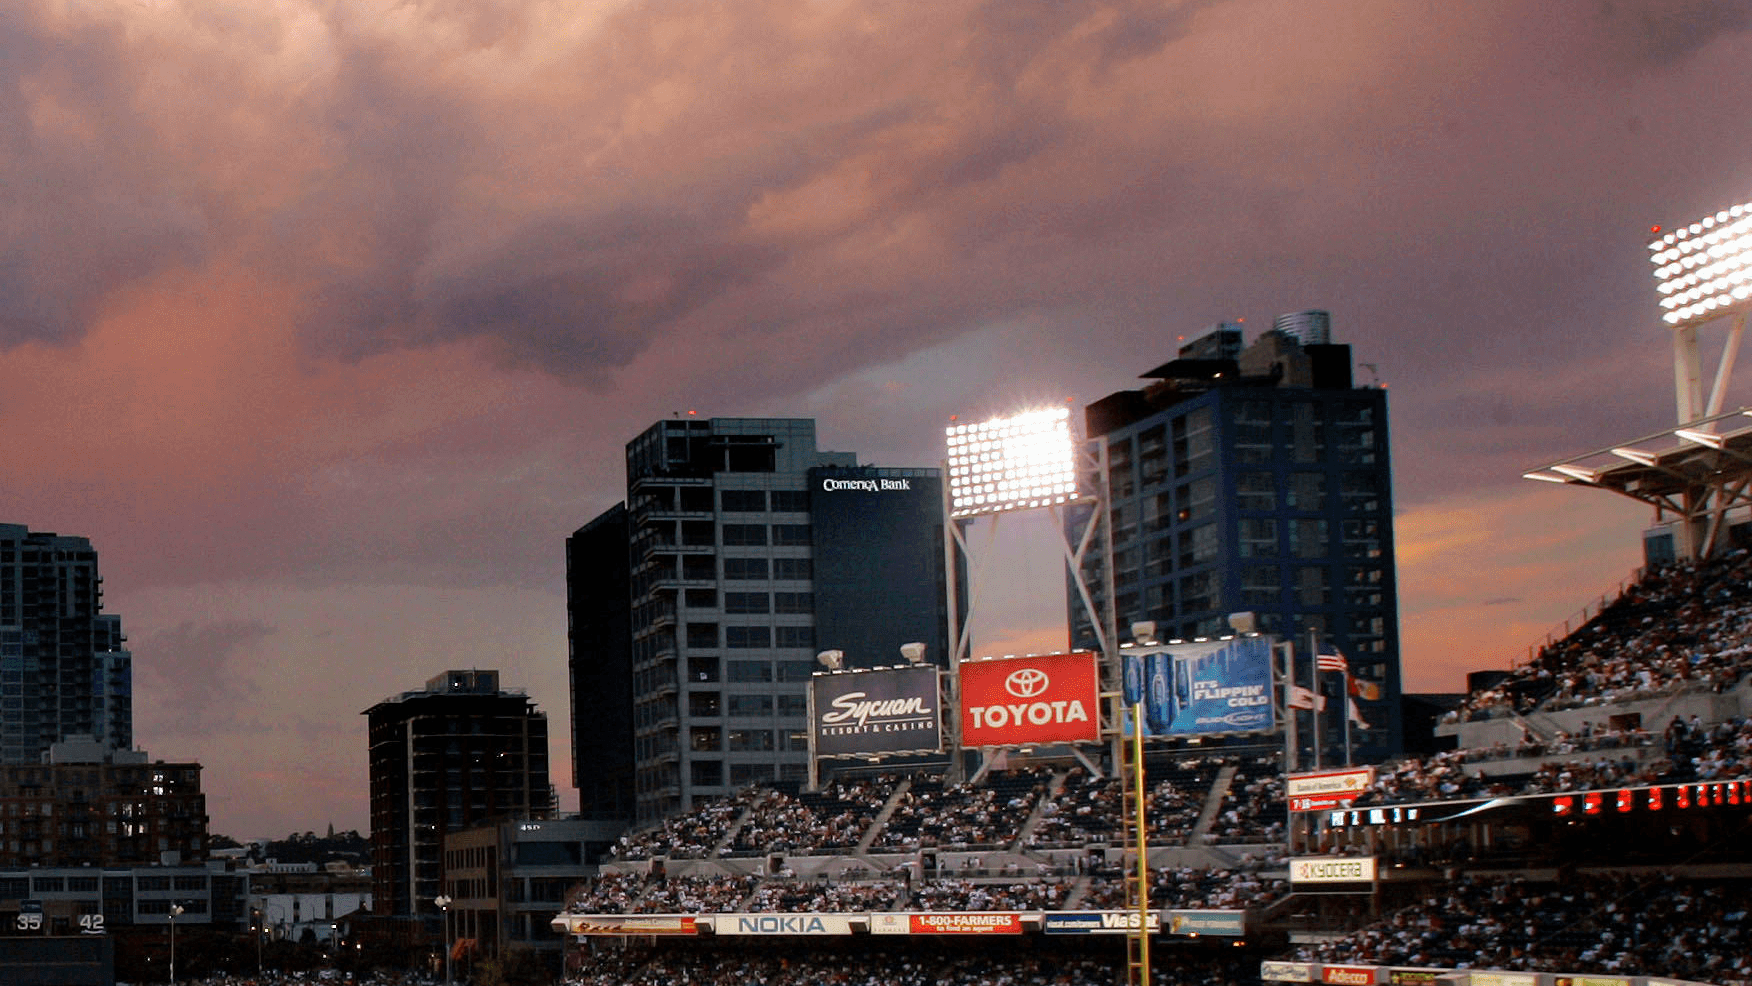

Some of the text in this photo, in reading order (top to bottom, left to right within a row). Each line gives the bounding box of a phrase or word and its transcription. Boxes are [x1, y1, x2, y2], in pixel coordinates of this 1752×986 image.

[881, 479, 910, 490] Bank
[1194, 684, 1263, 699] FLIPPIN'
[822, 692, 931, 726] Sycuan
[1228, 696, 1268, 707] COLD
[970, 700, 1088, 729] TOYOTA
[822, 726, 868, 736] RESORT
[885, 721, 933, 732] CASINO
[17, 915, 41, 930] 35
[80, 914, 104, 930] 42
[738, 917, 825, 933] NOKIA
[920, 916, 1012, 926] 1-800-FARMERS
